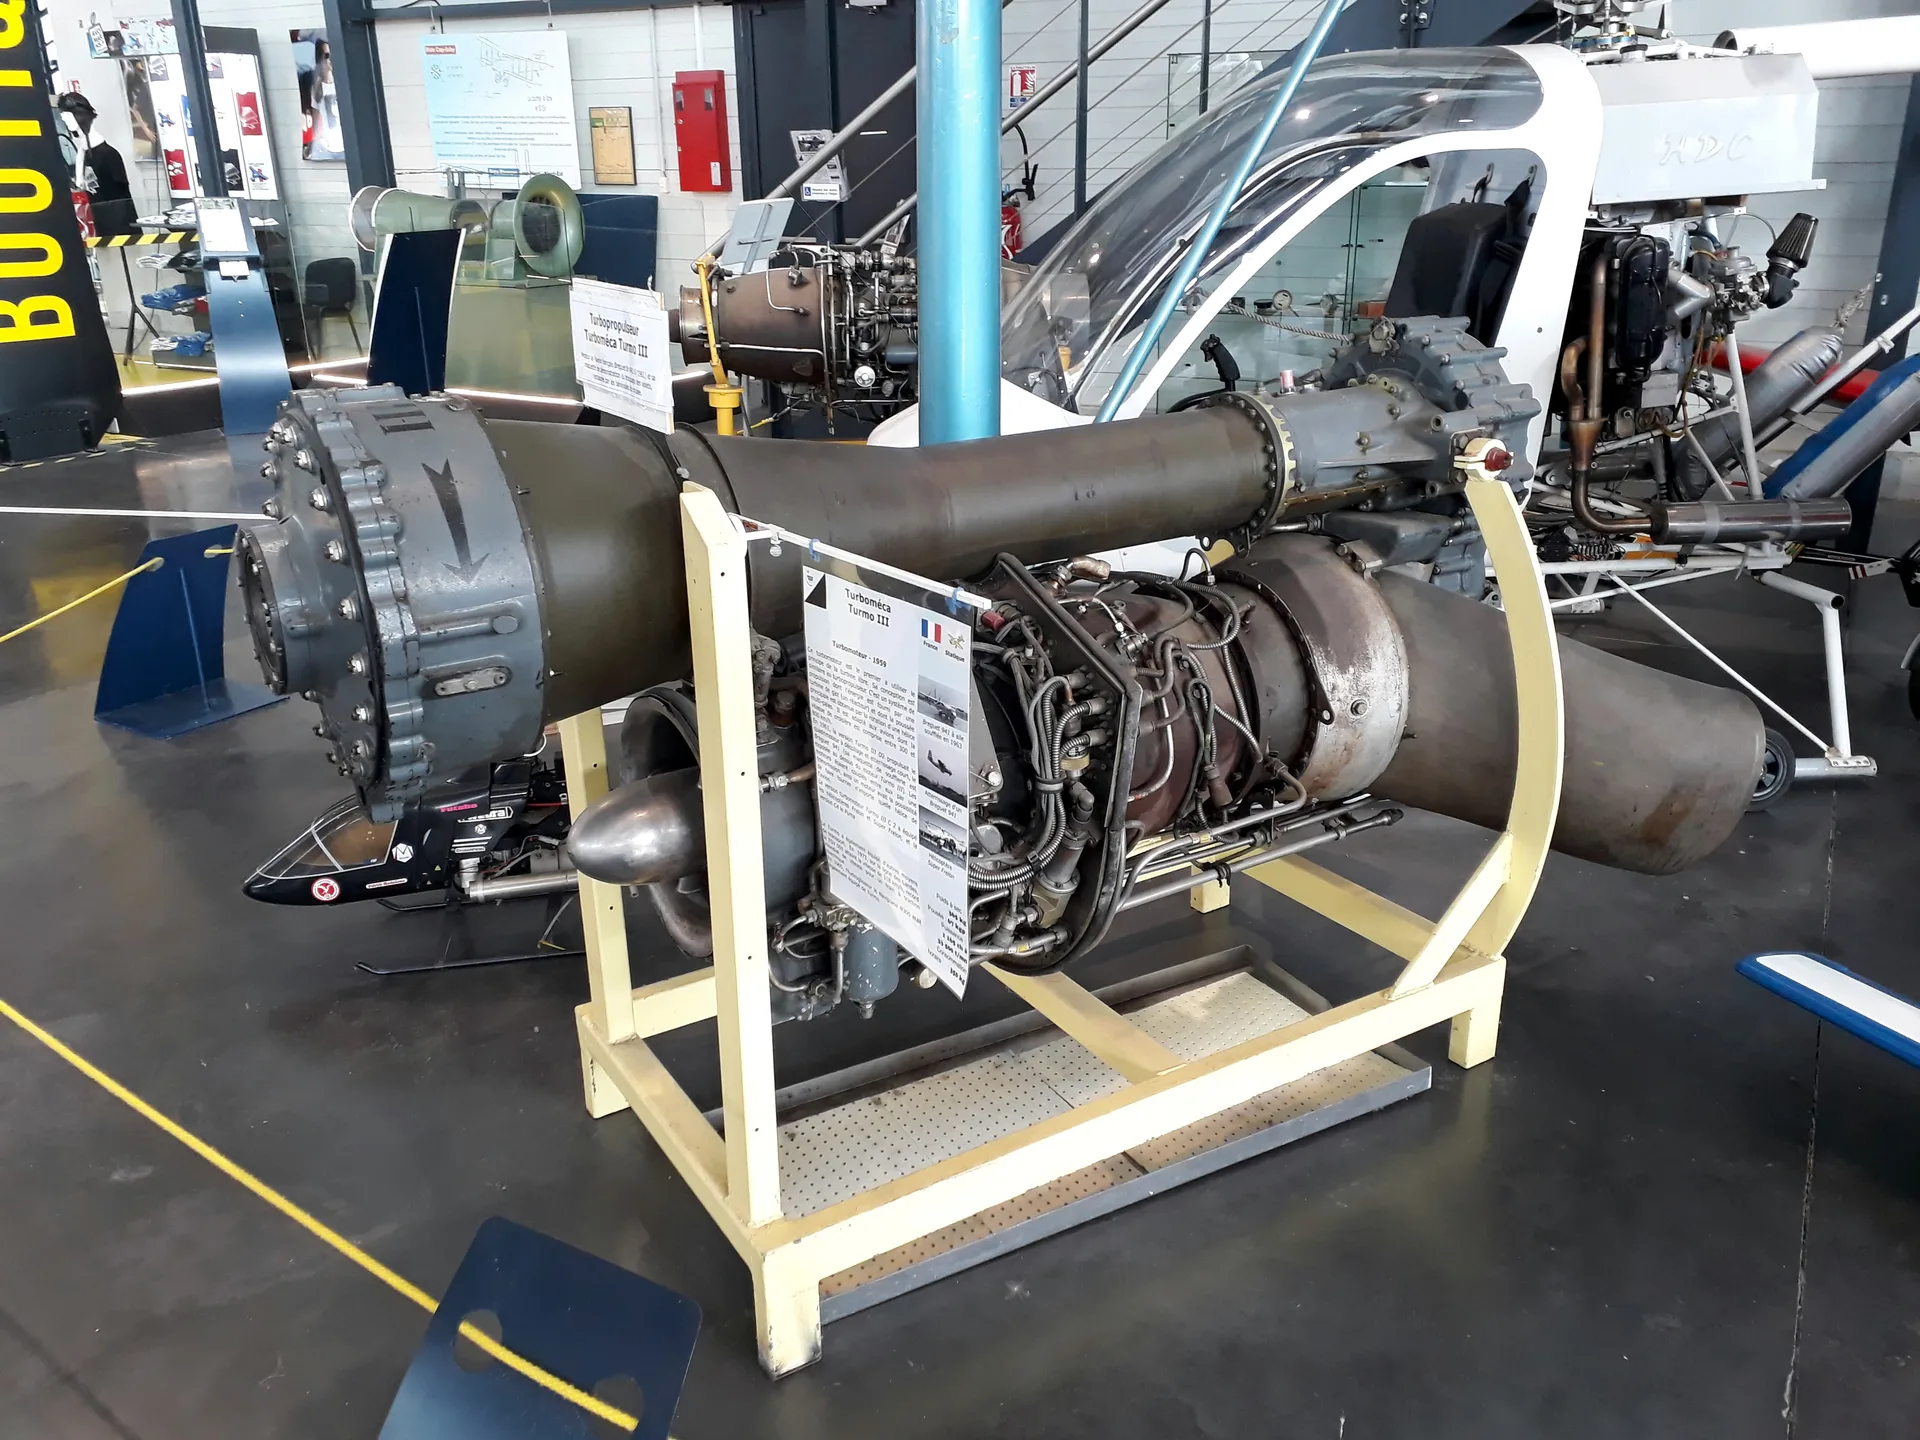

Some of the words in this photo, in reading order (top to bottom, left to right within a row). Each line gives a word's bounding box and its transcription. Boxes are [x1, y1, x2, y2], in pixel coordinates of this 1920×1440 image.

[0, 0, 76, 343] BOU
[589, 312, 640, 337] Turbopropulseur
[584, 329, 617, 349] Turboméca
[618, 338, 637, 354] Turmo
[638, 344, 649, 359] III
[844, 588, 891, 613] Turboméca
[848, 603, 875, 622] Turmo
[877, 613, 890, 627] III
[832, 640, 867, 660] Turbomoteur
[923, 640, 938, 651] France
